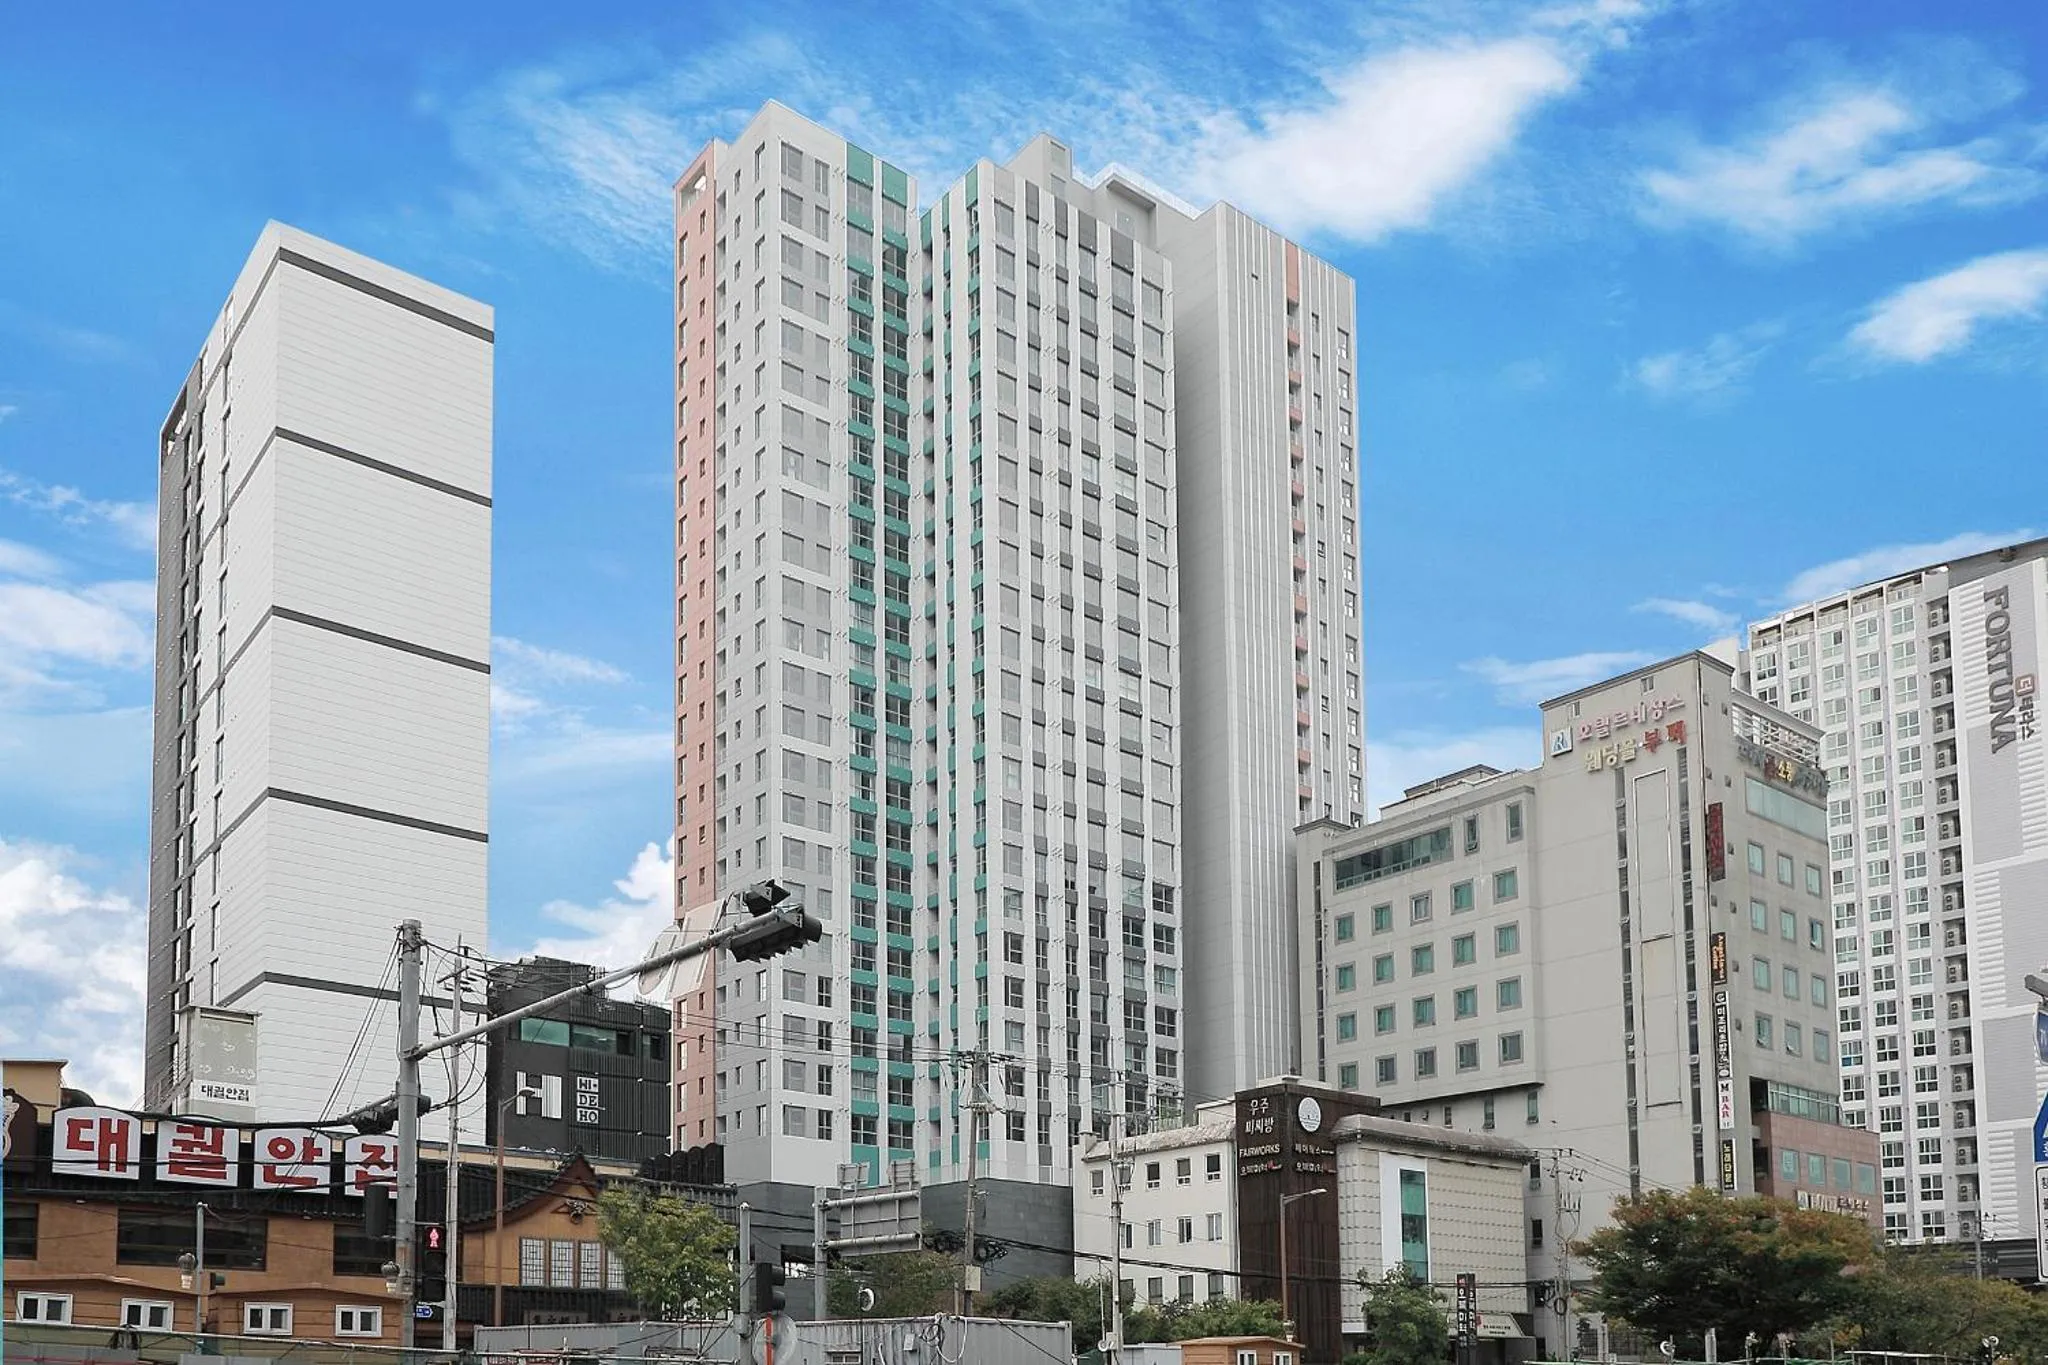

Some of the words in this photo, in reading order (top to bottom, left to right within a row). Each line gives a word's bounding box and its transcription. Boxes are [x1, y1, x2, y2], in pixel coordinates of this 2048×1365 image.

[1984, 585, 2017, 754] FORTUNA
[2018, 697, 2035, 741] 테라스
[201, 1084, 249, 1101] 대궐안집
[579, 1094, 598, 1106] DE
[1250, 1097, 1269, 1115] 우주
[1722, 1095, 1730, 1118] BAR
[579, 1110, 598, 1122] HO
[1239, 1143, 1280, 1158] FAIRWORKS
